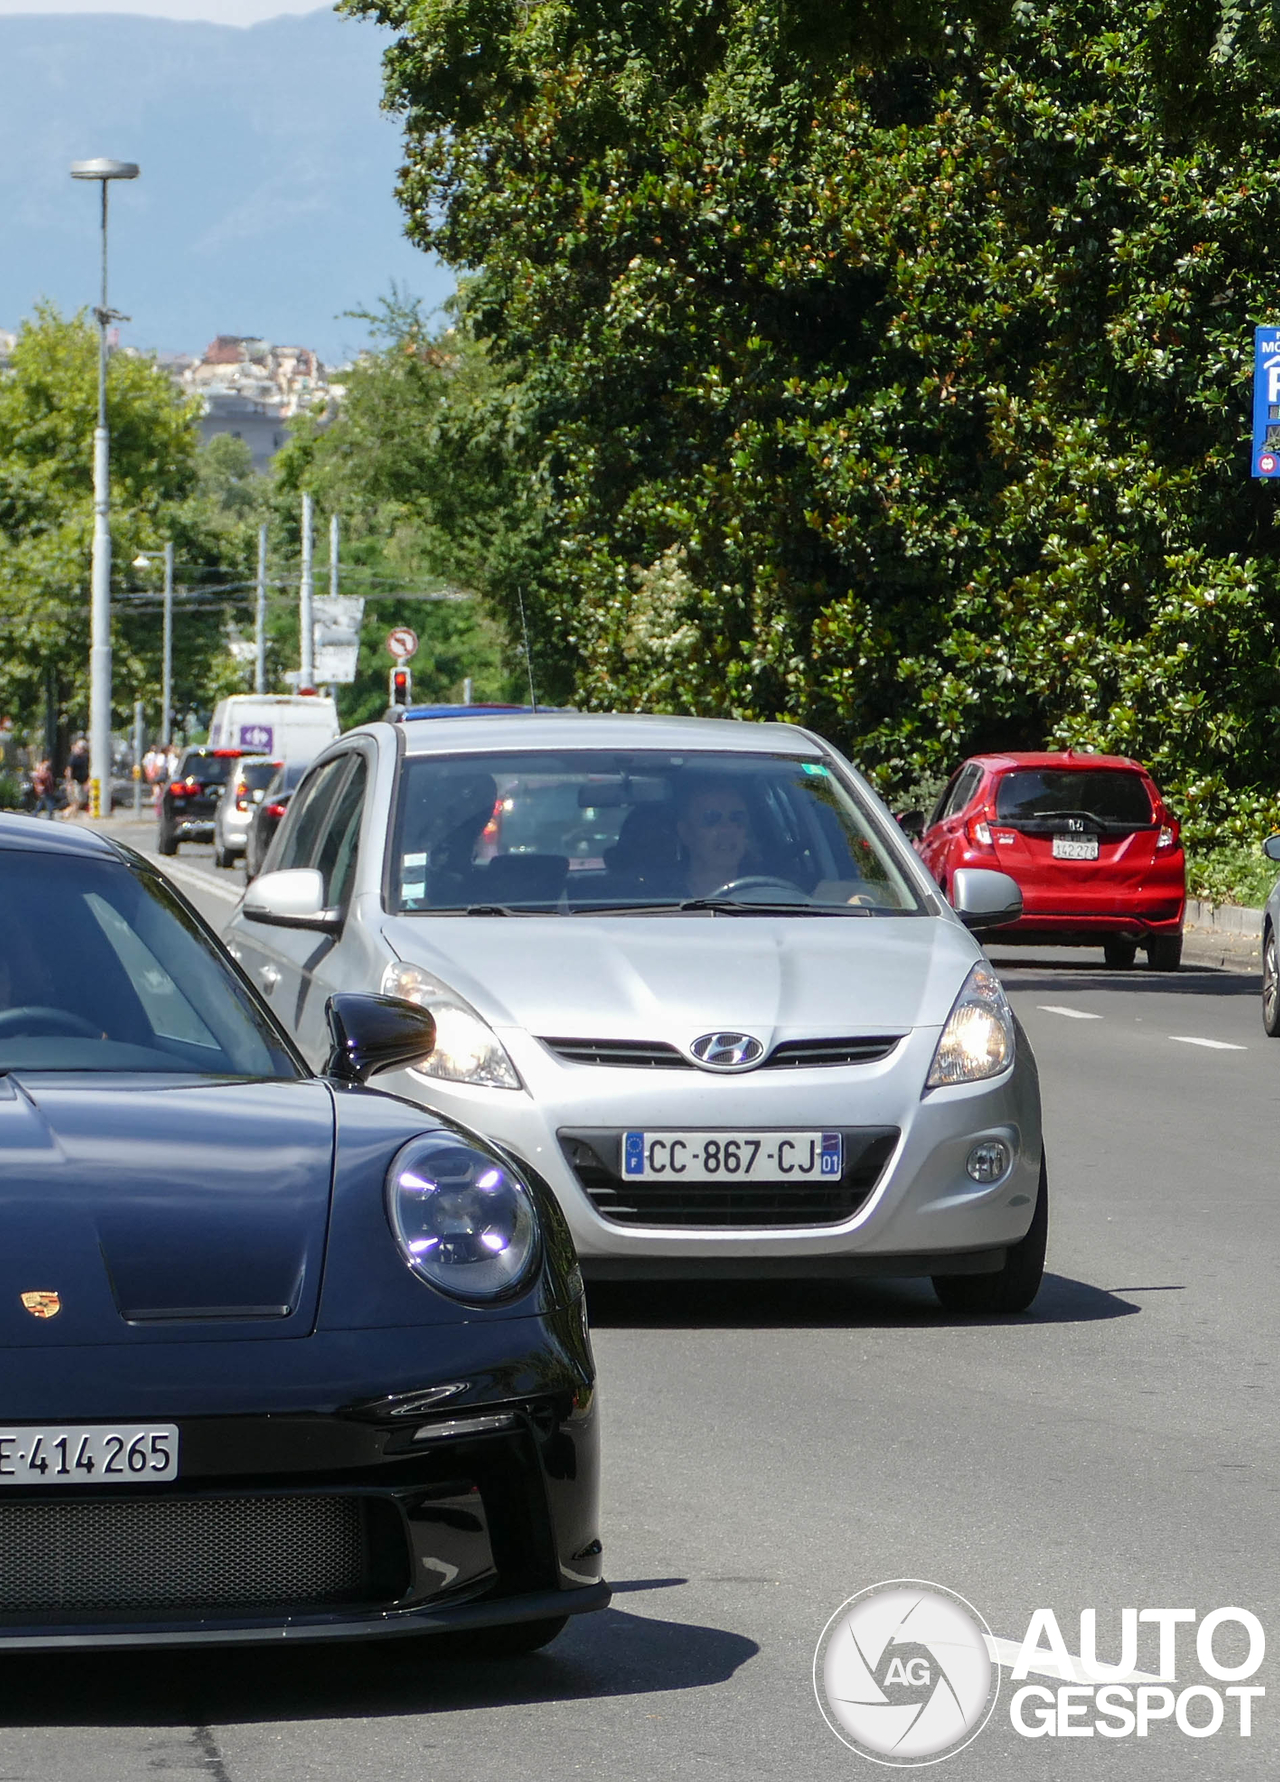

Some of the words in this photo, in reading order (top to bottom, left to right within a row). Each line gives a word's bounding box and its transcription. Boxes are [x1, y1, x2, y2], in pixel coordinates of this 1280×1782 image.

[630, 1157, 638, 1168] F
[649, 1139, 816, 1174] CC-867-CJ
[822, 1155, 839, 1172] 01
